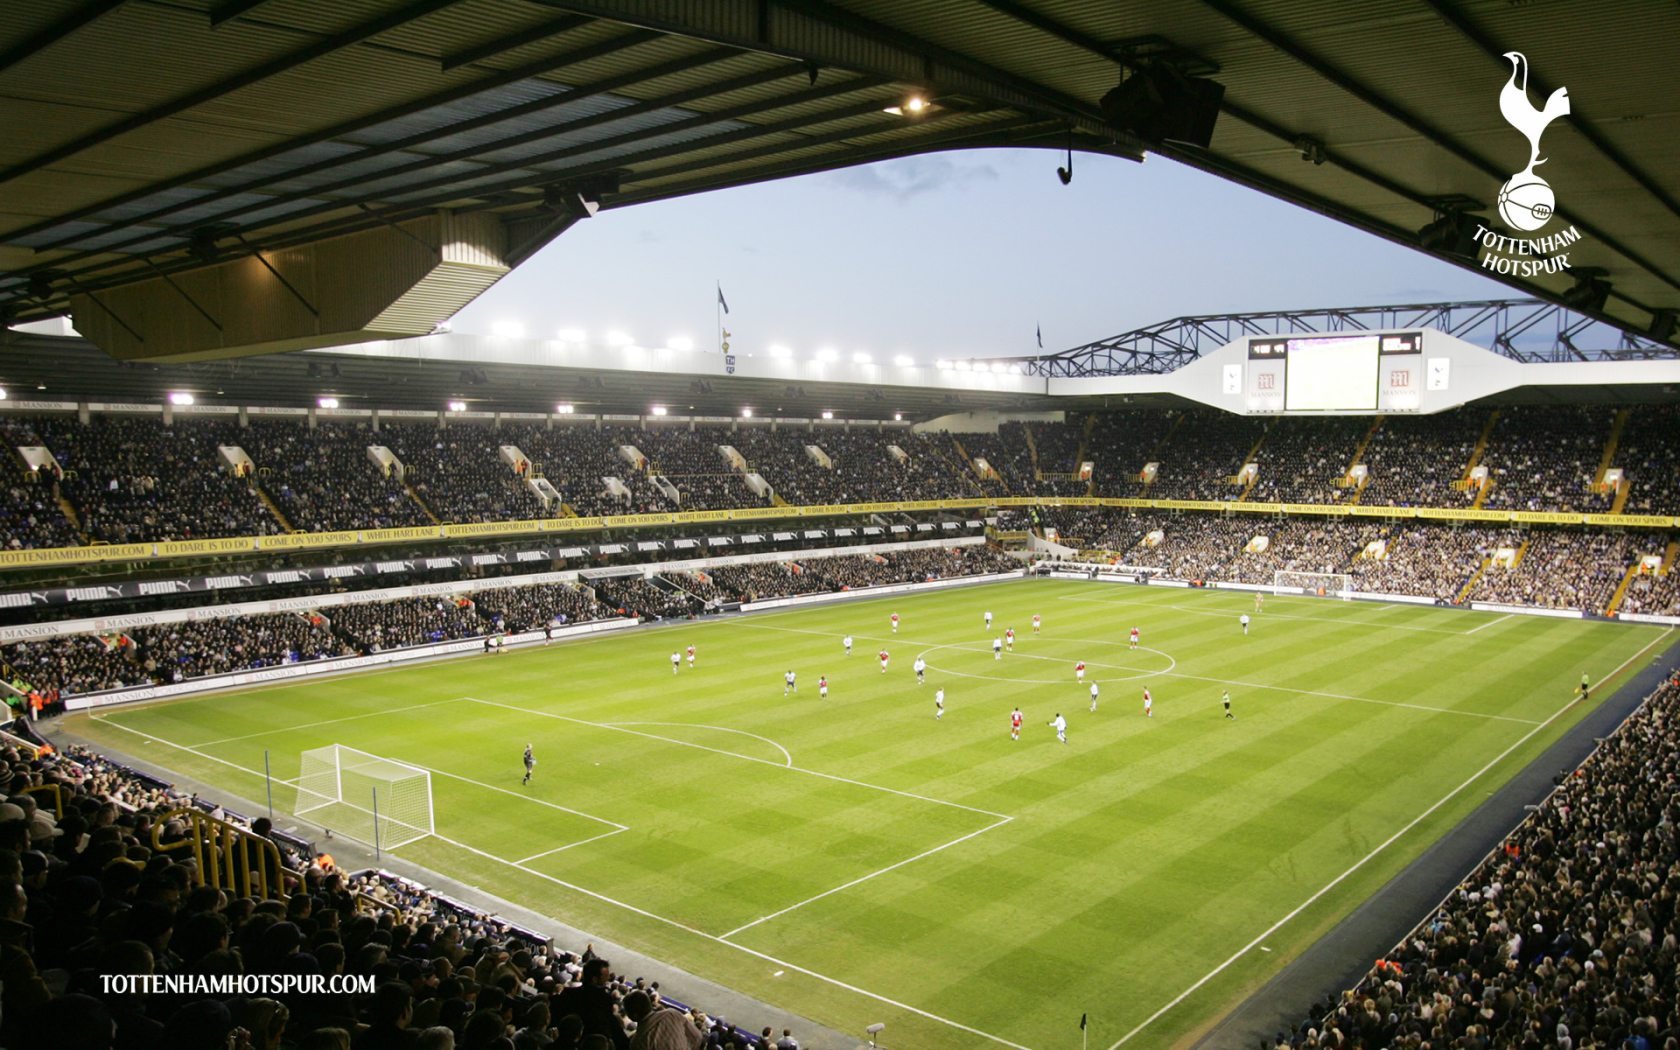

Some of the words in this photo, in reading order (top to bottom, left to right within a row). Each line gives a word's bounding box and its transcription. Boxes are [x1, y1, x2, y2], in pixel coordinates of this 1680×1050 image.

[610, 517, 627, 525] COME
[629, 516, 637, 524] ON
[638, 515, 650, 523] YOU
[651, 514, 669, 522] SPURS
[678, 513, 695, 521] WHITE
[697, 512, 711, 520] HART
[712, 511, 726, 519] LANE
[1528, 512, 1546, 520] DARE
[1568, 513, 1578, 521] DO
[1591, 514, 1611, 522] COME
[1613, 515, 1624, 523] ON
[1643, 516, 1668, 525] SPURS
[449, 522, 535, 535] TOTTENHAMHOTSPUR.COM
[546, 521, 555, 529] TO
[556, 520, 573, 528] DARE
[575, 519, 581, 527] IS
[591, 518, 600, 526] DO
[264, 537, 288, 547] COME
[291, 536, 304, 545] ON
[306, 535, 323, 544] YOU
[325, 533, 351, 543] SPURS
[366, 531, 391, 540] WHITE
[394, 530, 414, 538] HART
[416, 528, 435, 537] LANE
[165, 543, 178, 554] TO
[180, 542, 206, 552] DARE
[208, 541, 217, 551] IS
[220, 540, 232, 550] TO
[235, 539, 249, 549] DO
[0, 546, 145, 563] TOTTENHAMHOTSPUR.COM
[471, 554, 498, 566] PUMA
[516, 551, 541, 562] PUMA
[376, 561, 405, 574] PUMA
[426, 557, 453, 569] PUMA
[266, 570, 300, 584] PUMA
[323, 566, 354, 579] PUMA
[539, 573, 569, 582] MANSION
[138, 581, 177, 595] PUMA
[205, 575, 241, 590] PUMA
[481, 580, 513, 588] MANSION
[66, 587, 109, 602] PUMA
[419, 585, 453, 595] MANSION
[0, 592, 32, 608] UMA
[353, 592, 389, 602] MANSION
[279, 599, 319, 610] MANSION
[197, 607, 242, 618] MANSION
[107, 615, 155, 628] MANSION
[5, 626, 59, 639] MANSION
[255, 669, 296, 681] MANSION
